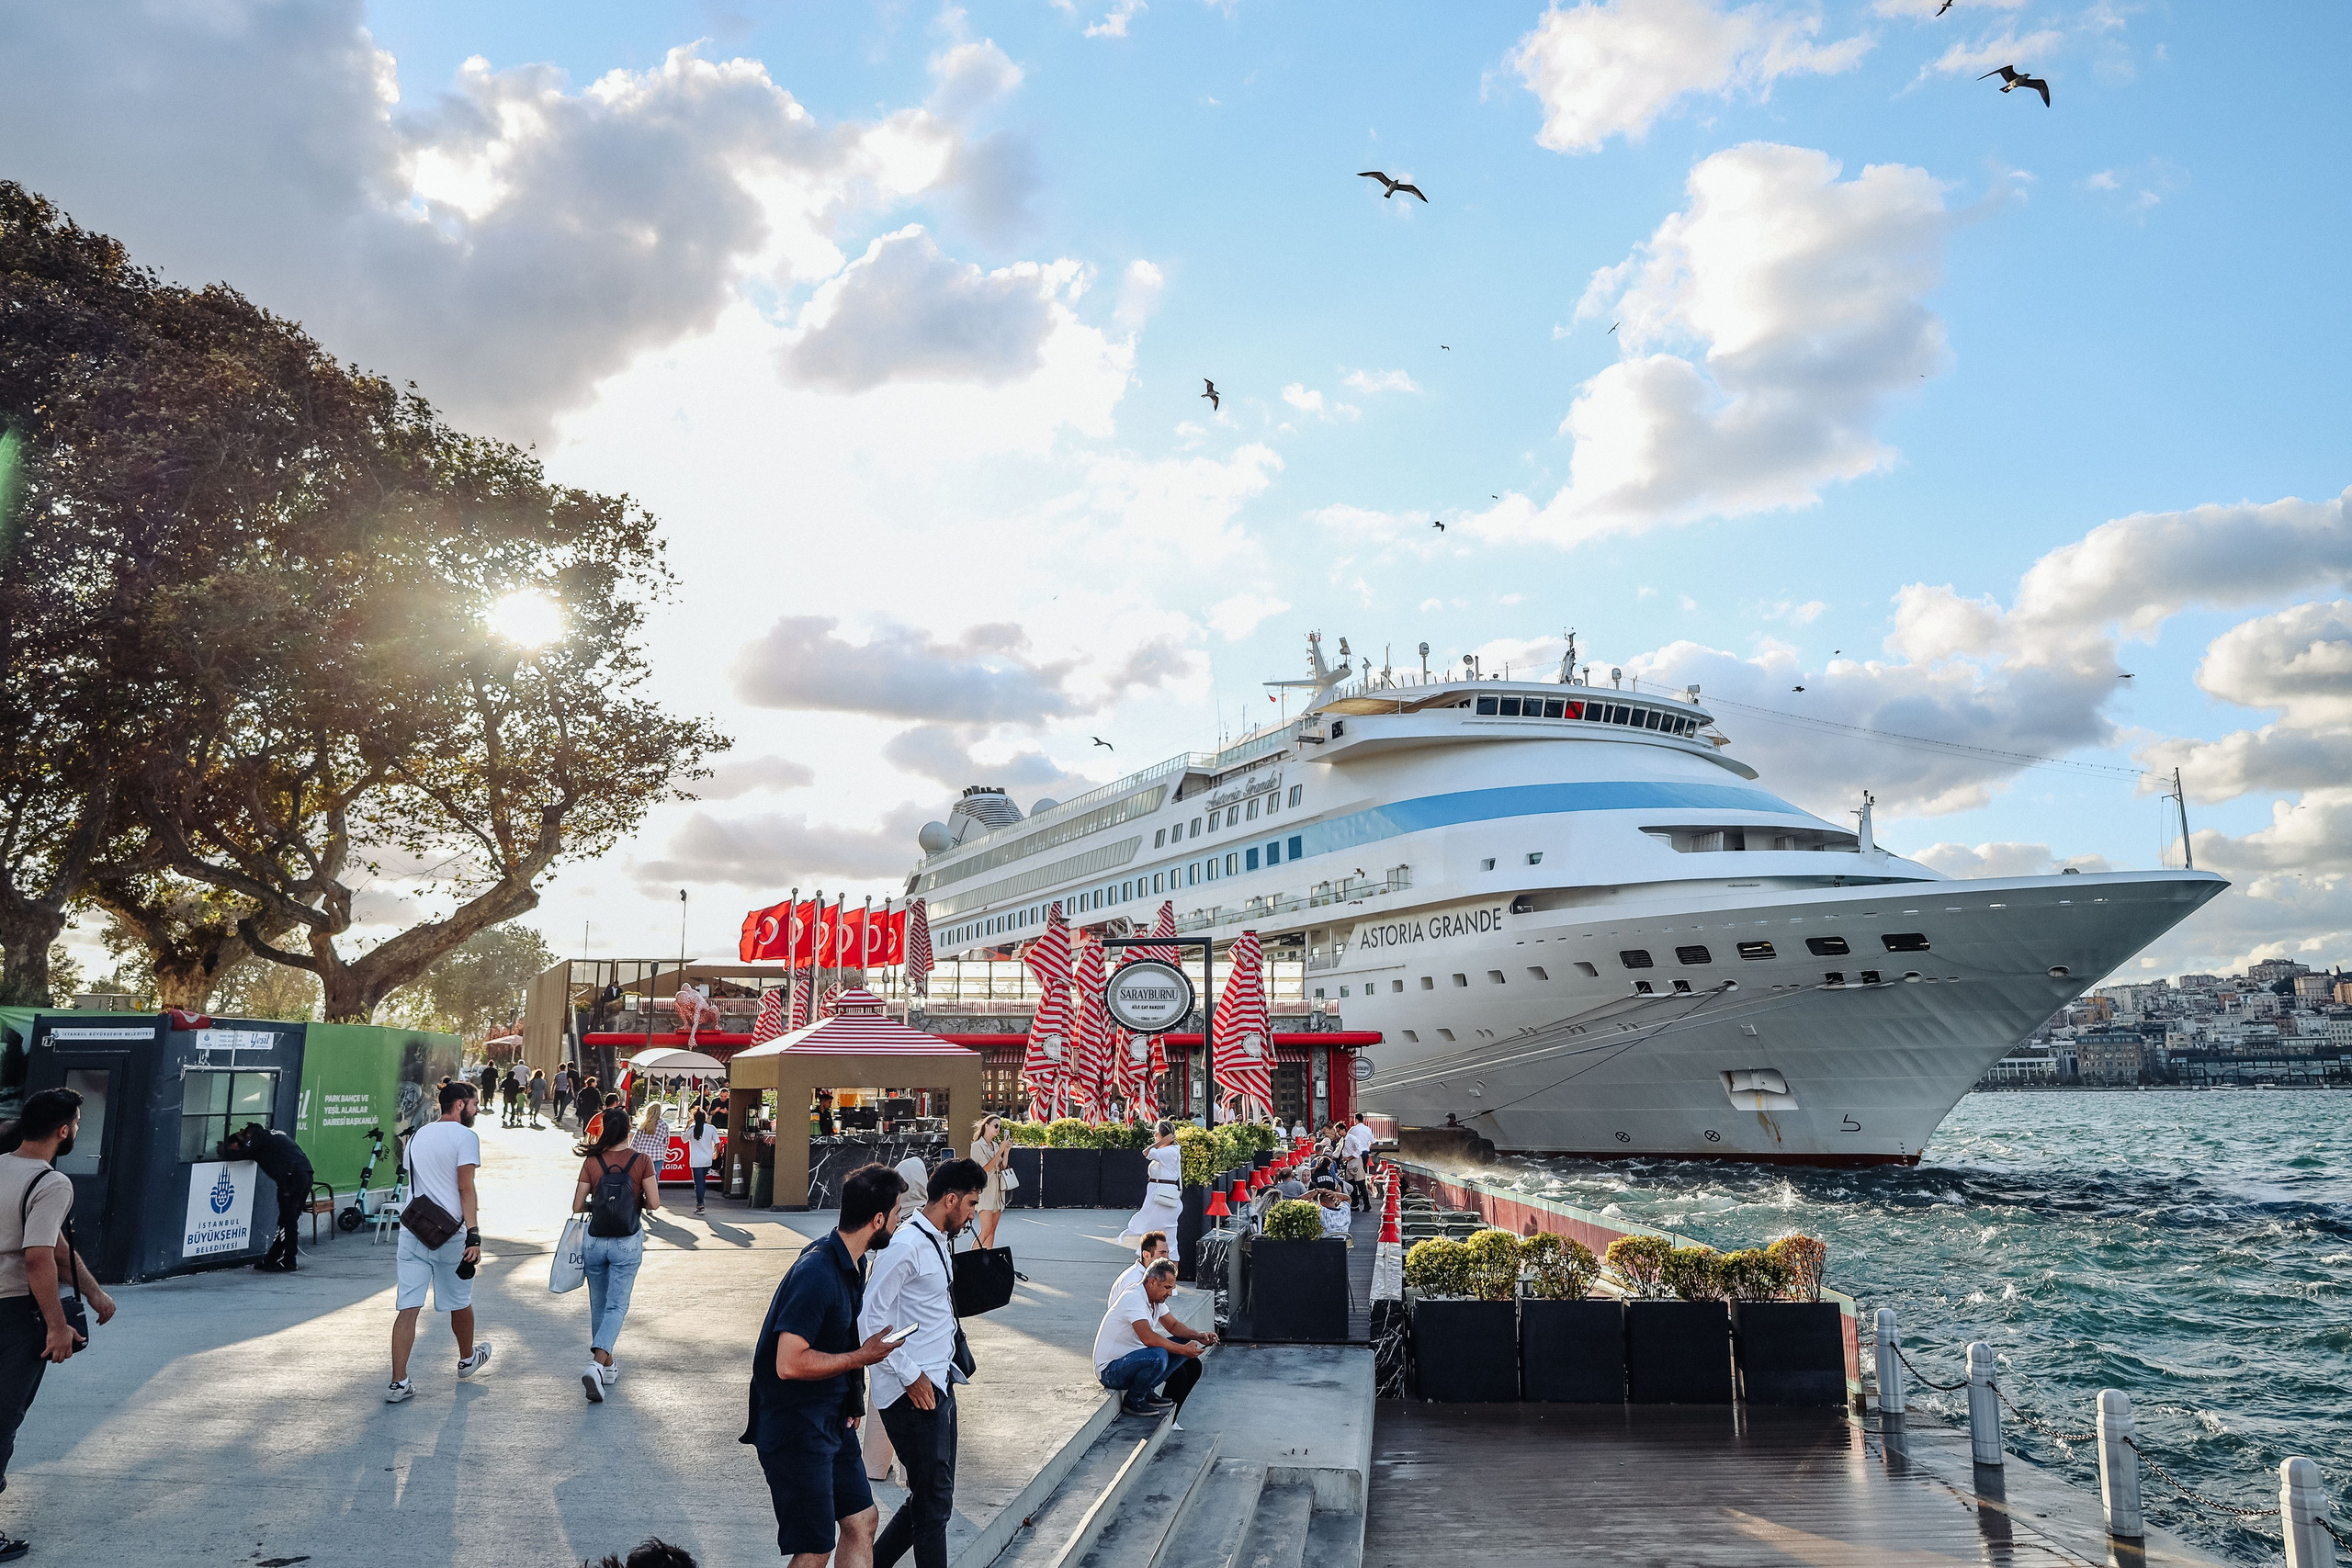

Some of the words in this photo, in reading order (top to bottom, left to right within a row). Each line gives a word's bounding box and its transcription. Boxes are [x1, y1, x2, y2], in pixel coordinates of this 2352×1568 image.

[1360, 920, 1424, 950] ASTORIA
[1429, 908, 1502, 939] GRANDE
[1120, 988, 1178, 999] SARAYBURNU
[341, 1094, 362, 1104] BAHÇE
[361, 1094, 369, 1102] VE
[323, 1104, 341, 1116] YEŞİL
[341, 1105, 368, 1114] ALANLAR
[322, 1115, 346, 1126] DAİRESİ
[345, 1114, 379, 1126] BAŞKANLIĞI
[198, 1218, 240, 1229] İSTANBUL
[187, 1226, 247, 1245] BÜYÜKŞEHİR
[196, 1241, 238, 1254] BELEDİYESİ
